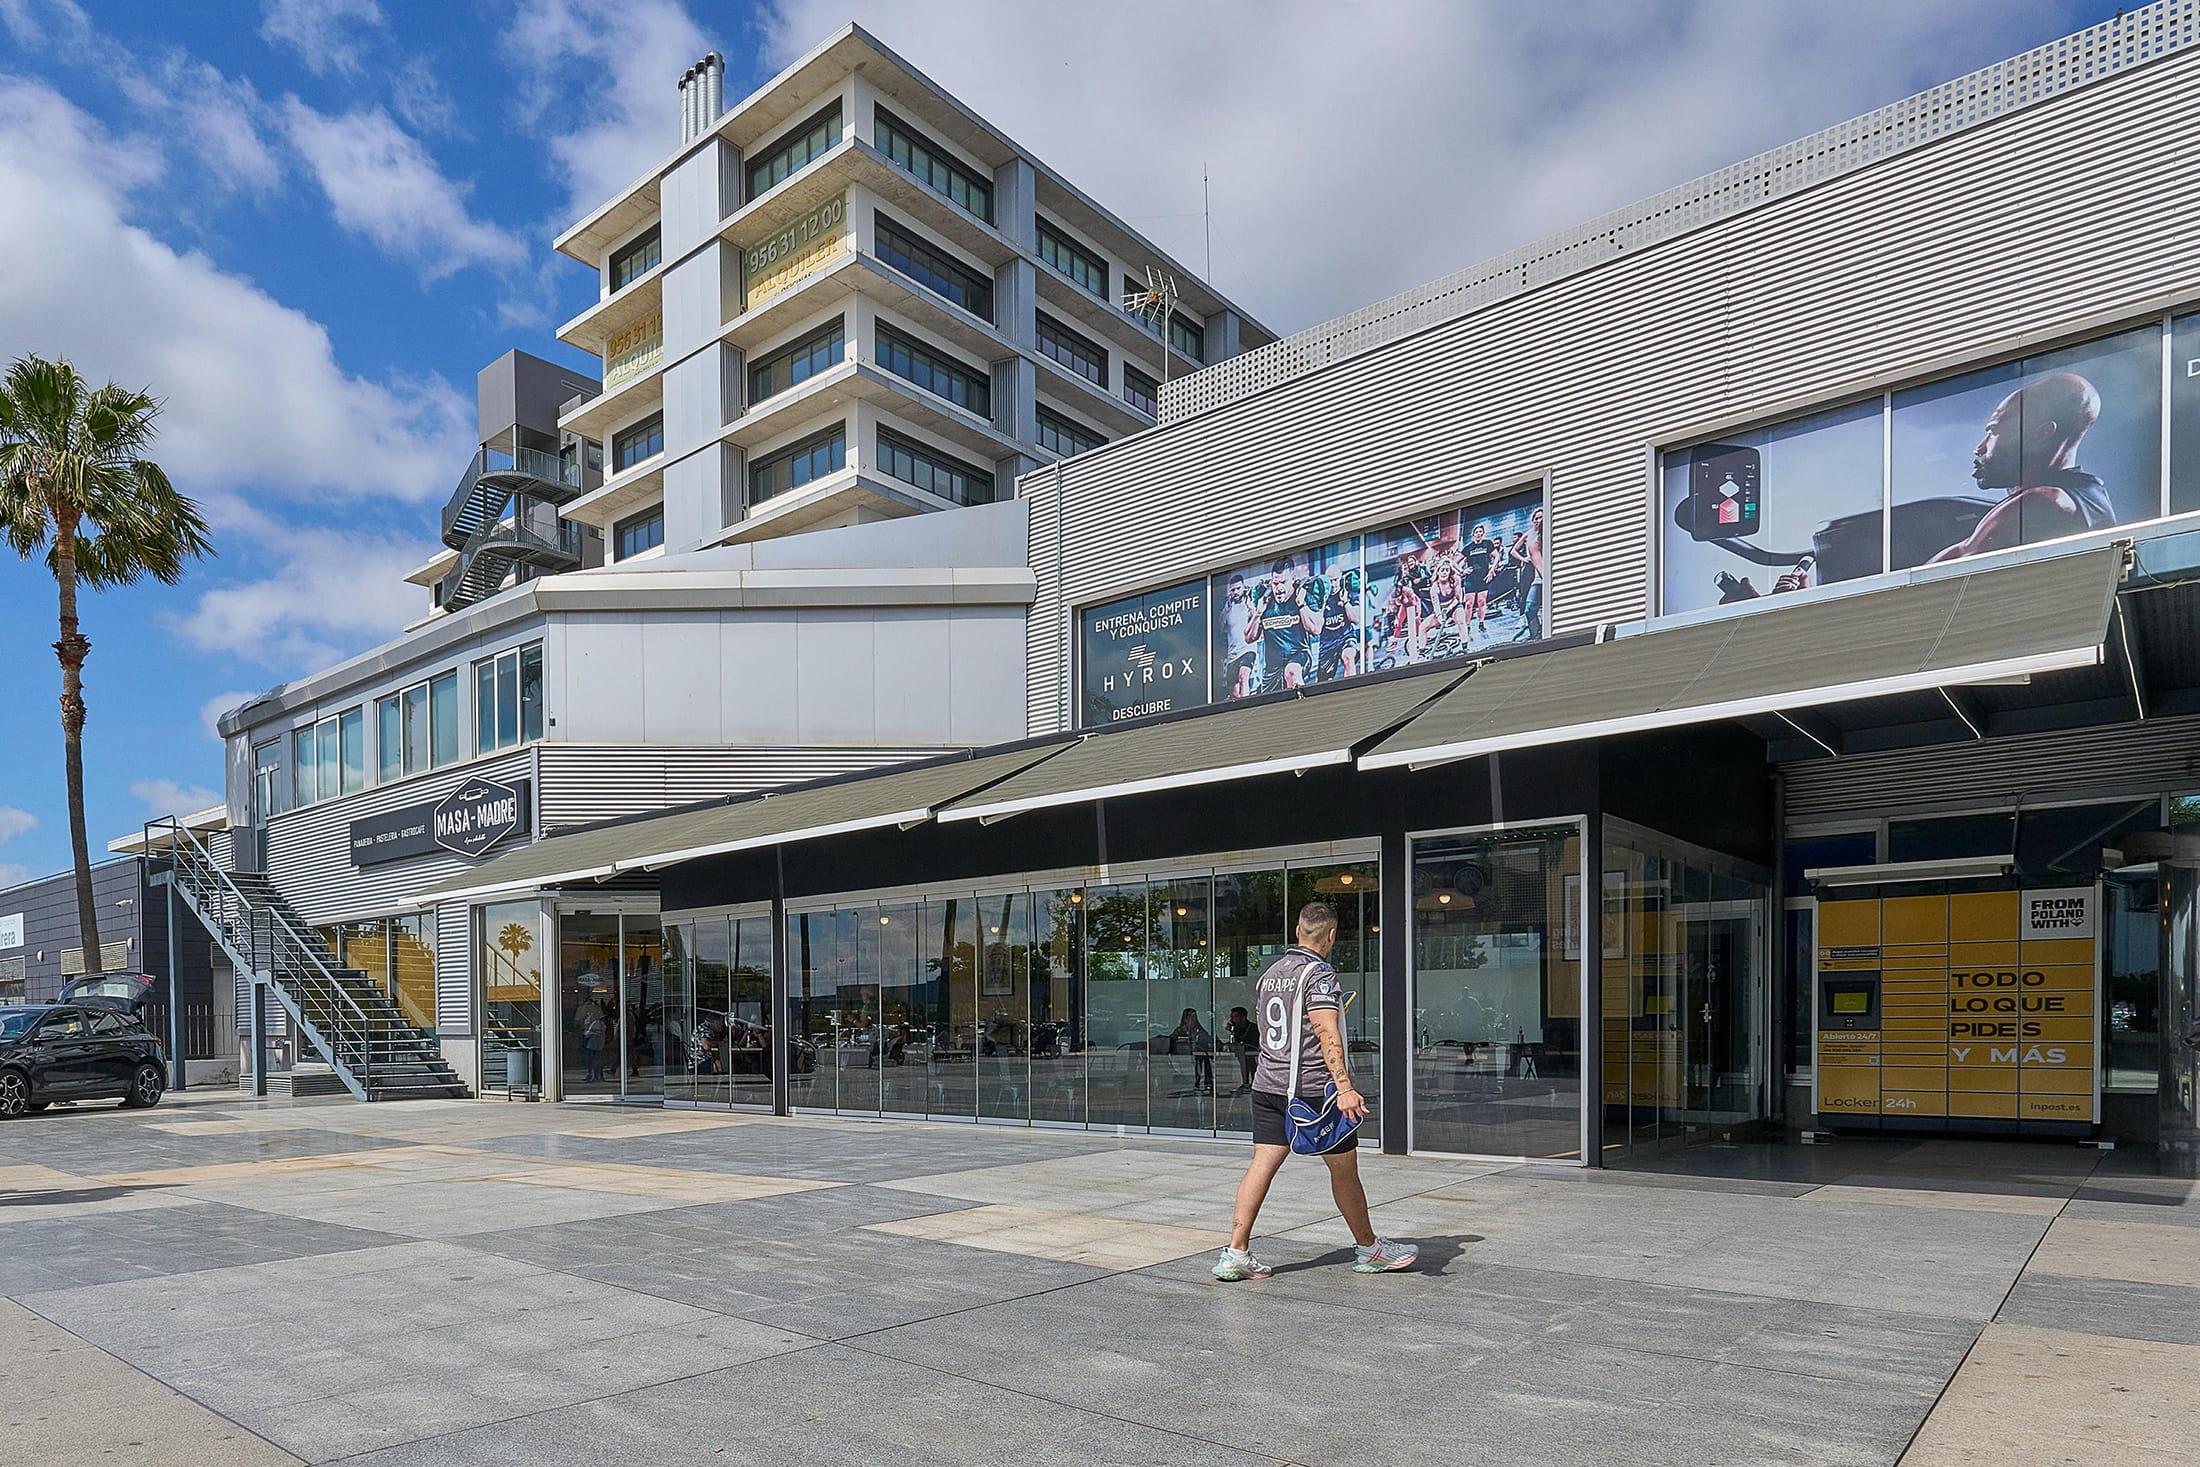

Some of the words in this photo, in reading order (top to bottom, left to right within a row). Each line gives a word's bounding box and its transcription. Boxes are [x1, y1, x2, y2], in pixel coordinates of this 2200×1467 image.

[750, 240, 778, 273] 956
[780, 227, 797, 256] 31
[801, 214, 819, 242] 12
[822, 199, 842, 229] 00
[755, 235, 838, 298] ALQUILER
[610, 331, 631, 359] 956
[633, 321, 647, 345] 31
[1095, 610, 1147, 632] ENTRENA,
[1149, 596, 1200, 619] COMPITE
[1325, 613, 1344, 626] aws
[1110, 629, 1117, 641] Y
[1119, 613, 1183, 638] CONQUISTA
[1104, 657, 1193, 692] HYROX
[1112, 699, 1171, 722] DESCUBRE
[2031, 898, 2084, 910] FROM
[2031, 909, 2084, 919] POLAND
[2031, 919, 2070, 929] WITH
[1951, 971, 2045, 988] TODO
[1951, 998, 1989, 1013] LO
[1993, 997, 2065, 1013] QUE
[1266, 996, 1288, 1050] 9
[1951, 1022, 2042, 1037] PIDES
[1823, 1032, 1856, 1040] Abierto
[1857, 1032, 1877, 1040] 24/7
[1951, 1047, 1971, 1063] Y
[1990, 1044, 2067, 1063] MÁS
[1824, 1097, 1880, 1107] Locker
[1886, 1098, 1917, 1109] 24h
[2030, 1102, 2080, 1111] inpost.es
